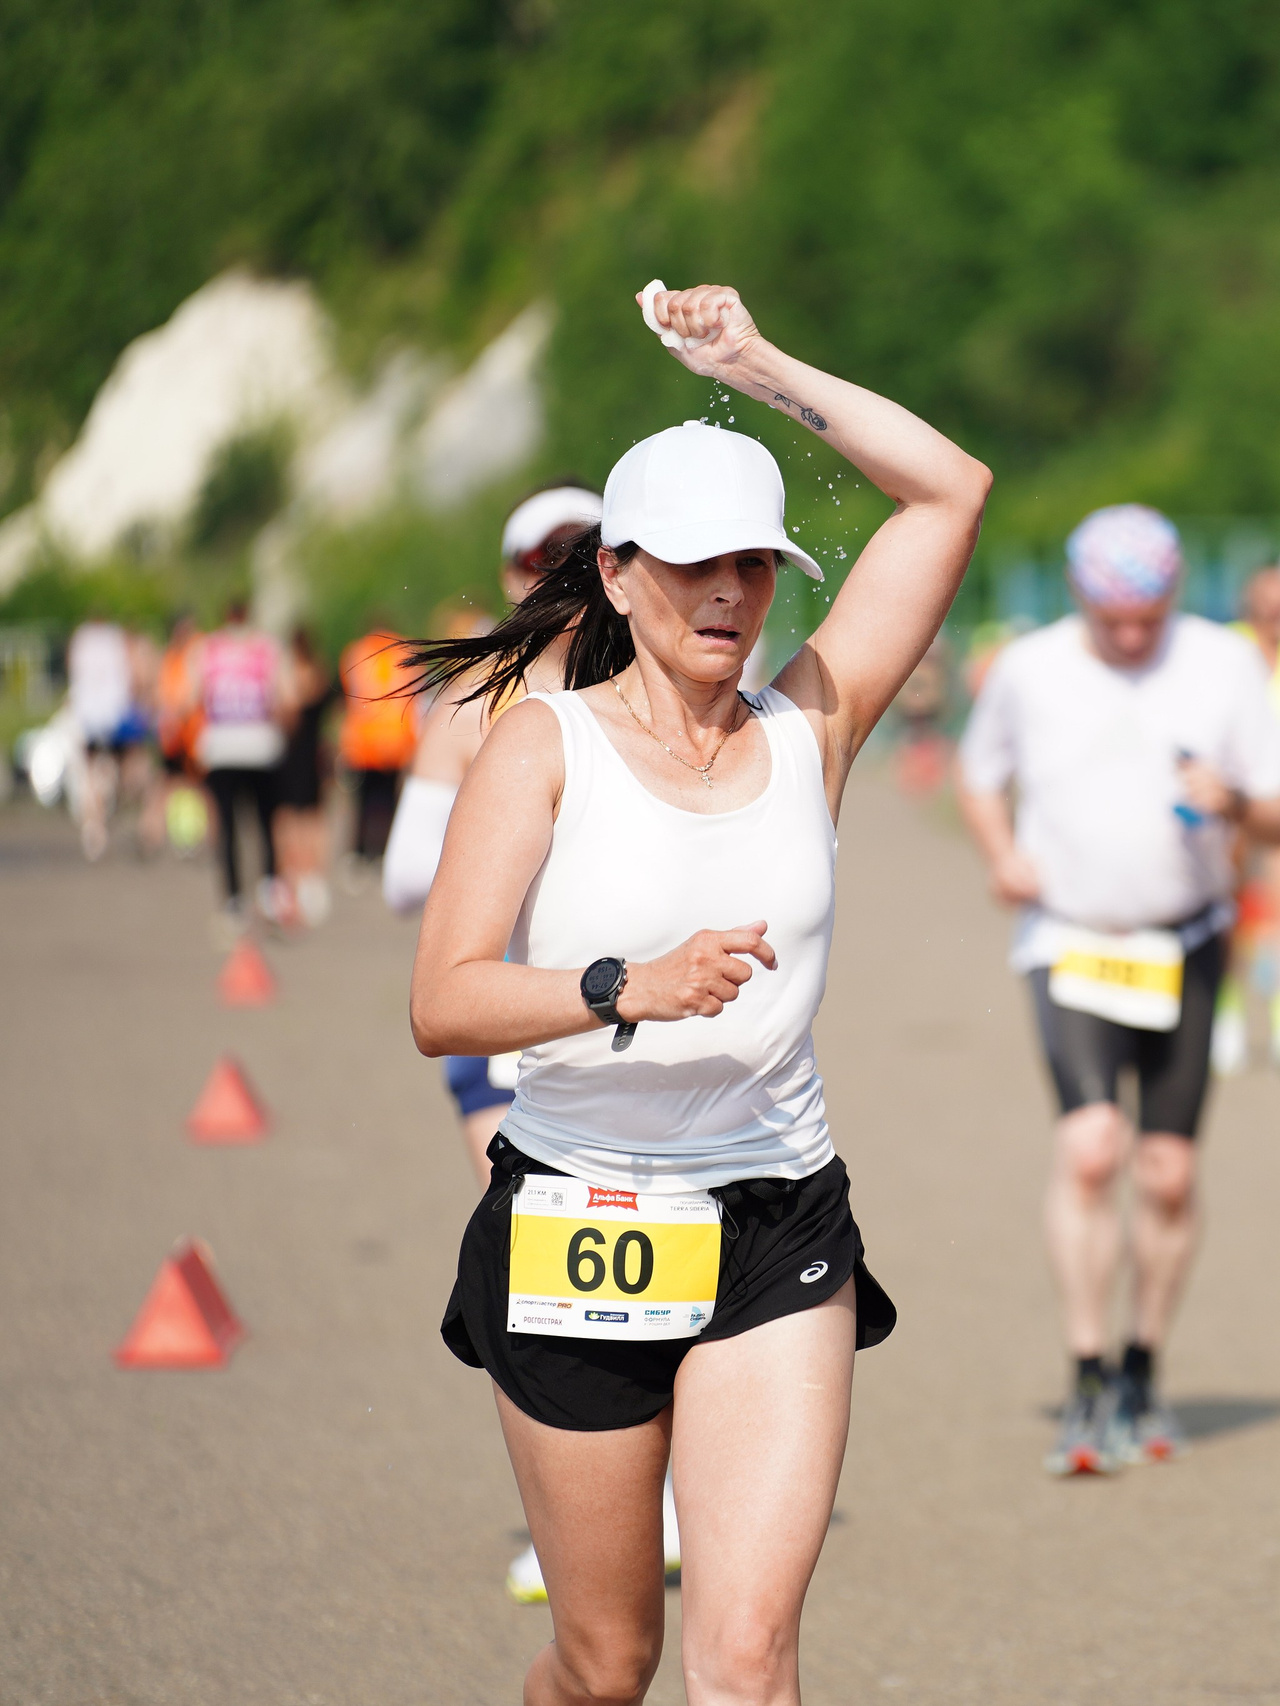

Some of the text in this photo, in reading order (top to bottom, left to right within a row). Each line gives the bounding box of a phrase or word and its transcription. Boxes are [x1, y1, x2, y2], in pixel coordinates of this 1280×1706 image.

[592, 1193, 634, 1203] Альфа Банк
[567, 1226, 654, 1295] 60
[523, 1316, 563, 1326] РОСГОССТРАХ
